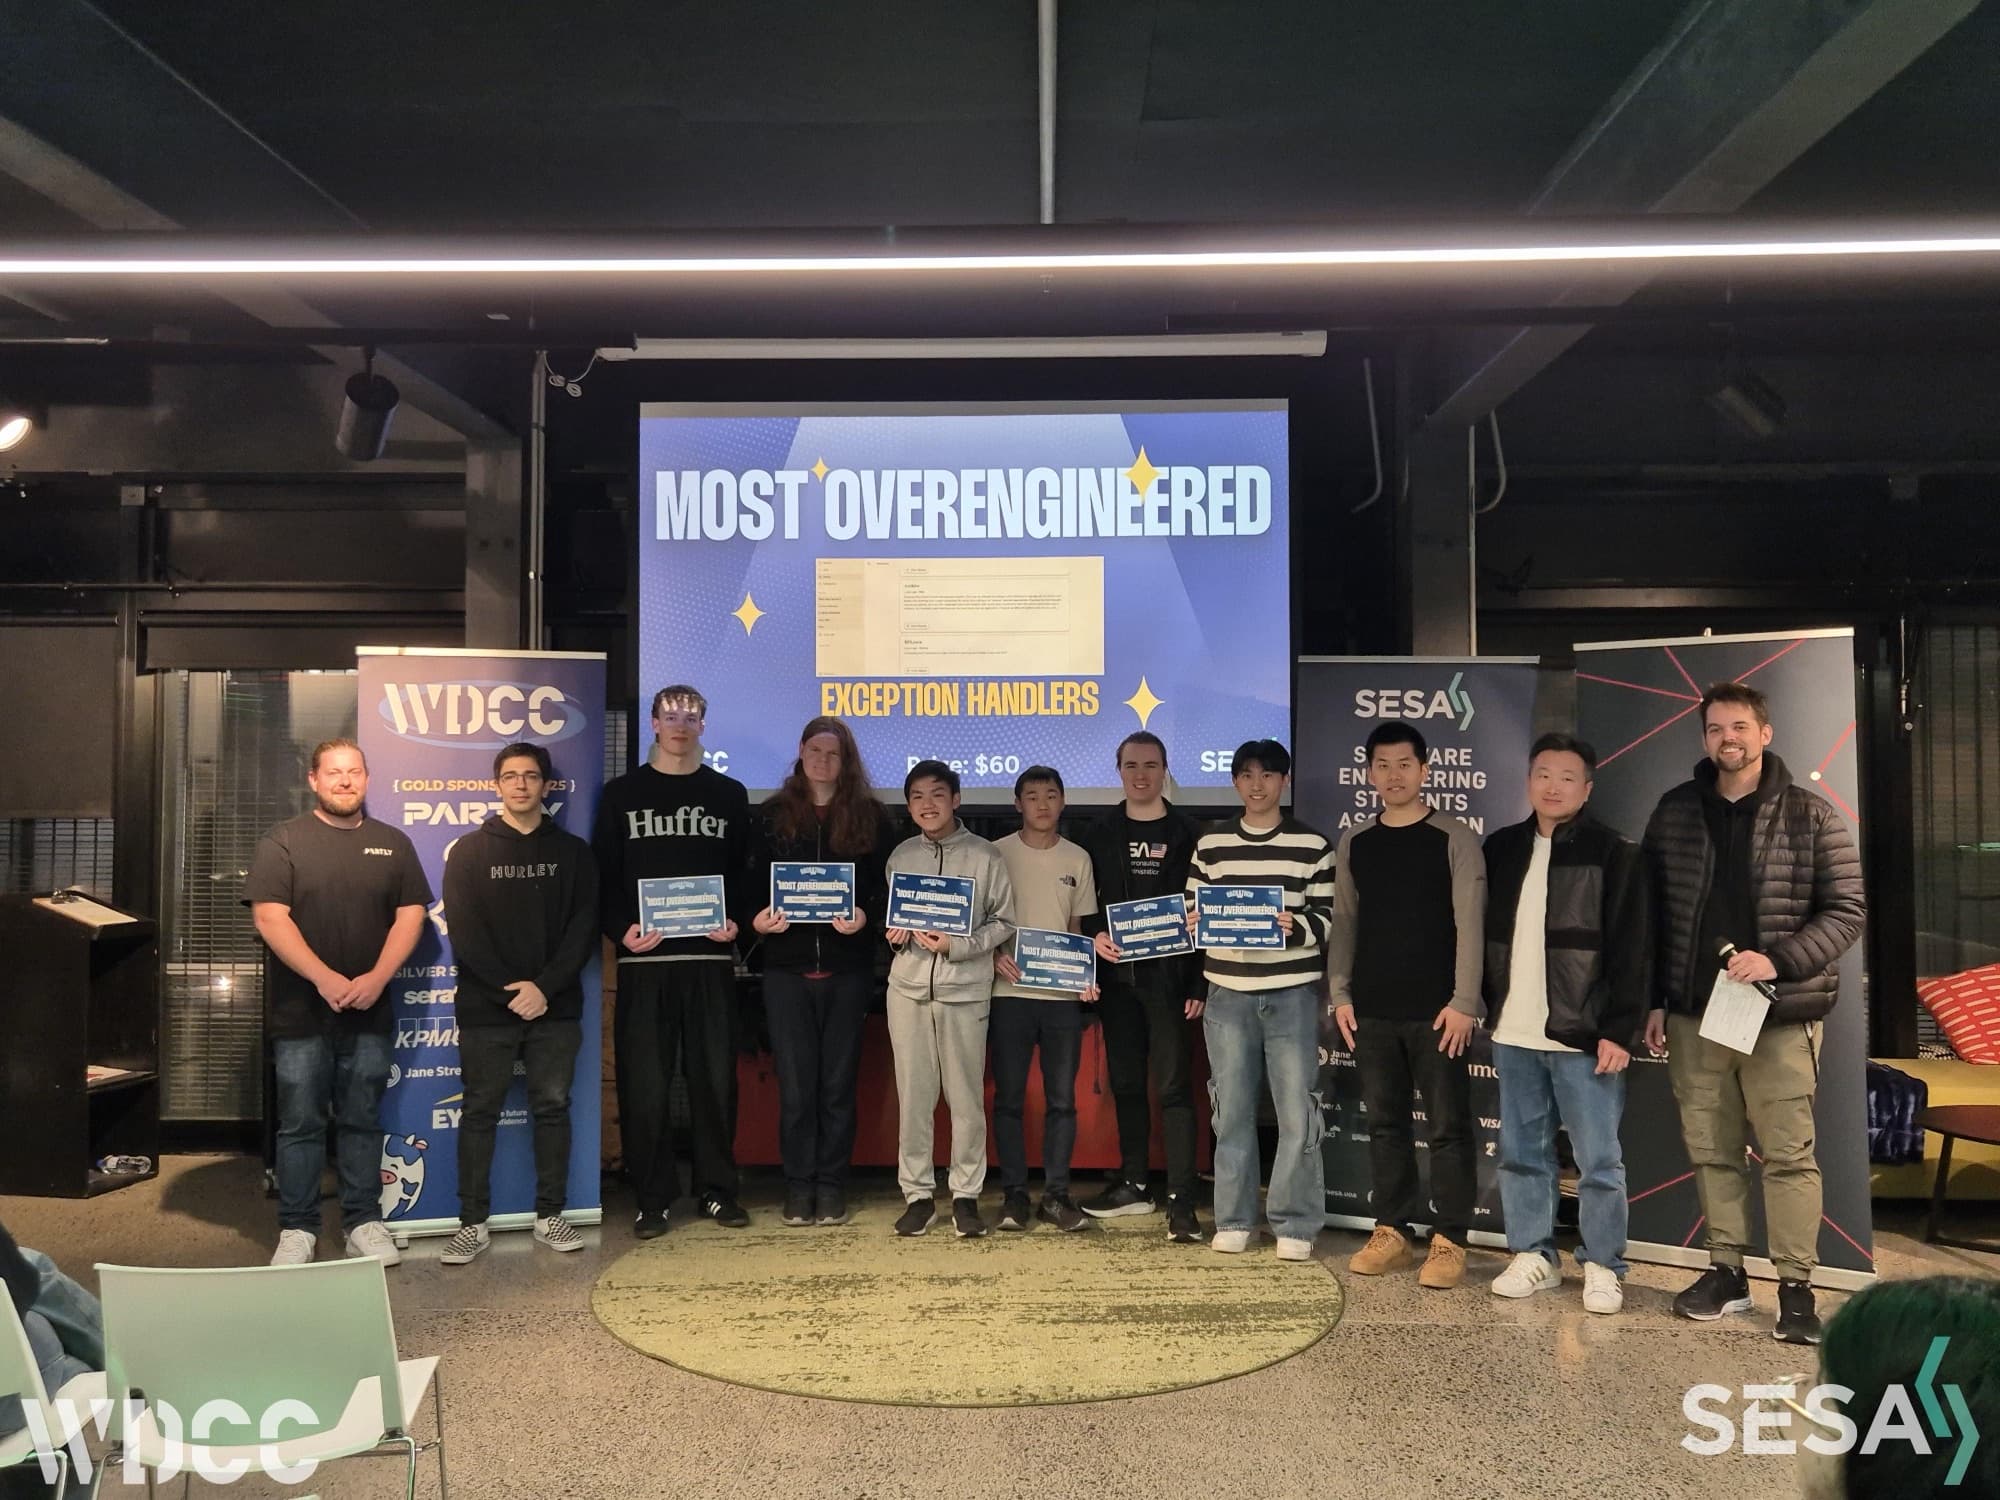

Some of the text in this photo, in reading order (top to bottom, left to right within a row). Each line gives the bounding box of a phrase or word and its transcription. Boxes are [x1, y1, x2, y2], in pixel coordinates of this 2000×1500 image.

[656, 465, 1272, 541] MOST OVERENGINEERED
[383, 683, 566, 735] WDCC
[821, 681, 1100, 718] EXCEPTION HANDLERS
[1354, 690, 1455, 718] SESA
[975, 753, 1020, 776] $60
[1200, 750, 1234, 772] SE
[1354, 746, 1473, 766] SARE
[402, 780, 444, 791] GOLD
[446, 780, 497, 791] SPONS
[1355, 790, 1468, 811] STNTS
[626, 806, 728, 840] Huffer
[364, 847, 393, 856] PARTLY
[491, 863, 558, 880] HURLEY
[404, 986, 458, 1005] sera
[1329, 1057, 1357, 1067] Street
[1330, 1049, 1351, 1059] Jane
[405, 1066, 462, 1079] Jane Stre
[432, 1109, 463, 1129] EY
